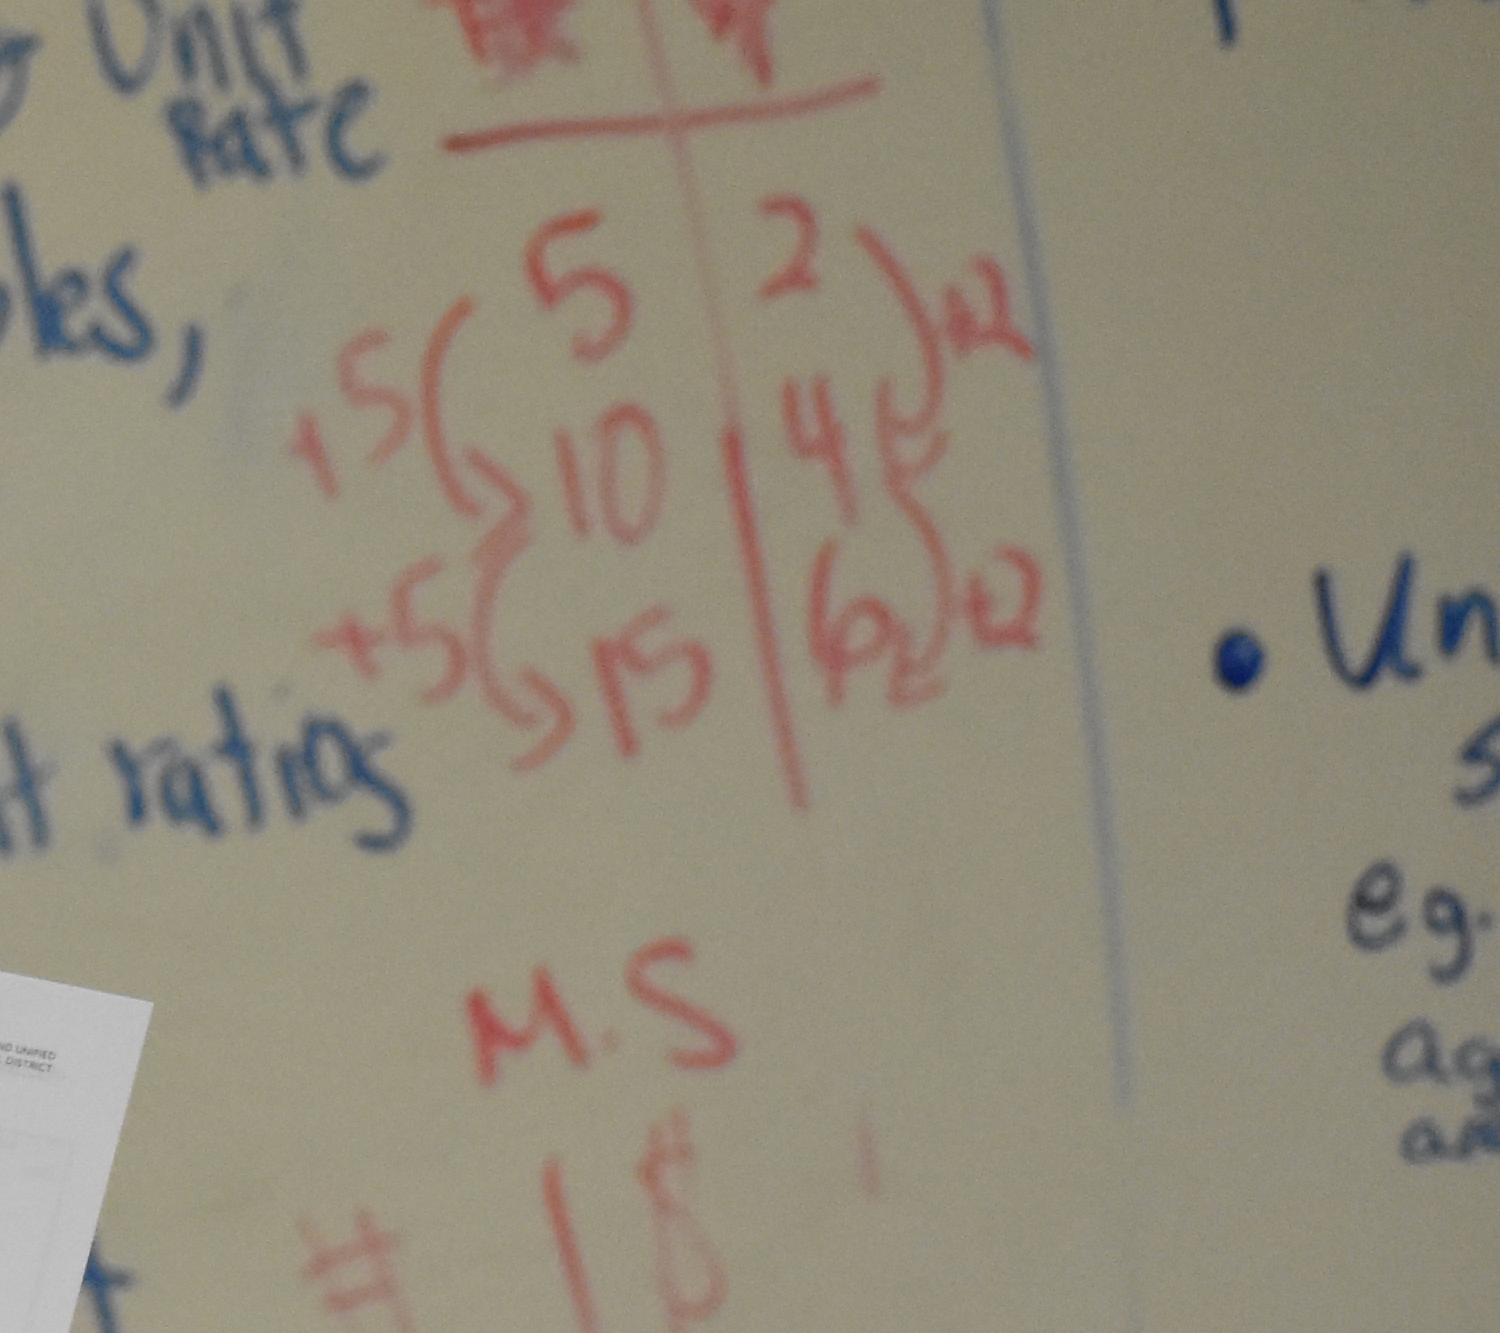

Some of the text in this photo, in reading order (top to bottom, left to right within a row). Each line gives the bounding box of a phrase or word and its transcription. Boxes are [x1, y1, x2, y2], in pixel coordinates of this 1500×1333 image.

[524, 208, 636, 360] 5
[757, 192, 822, 303] 2
[552, 402, 667, 546] 10
[781, 373, 861, 529] 4
[5, 1056, 53, 1073] DISTRICT
